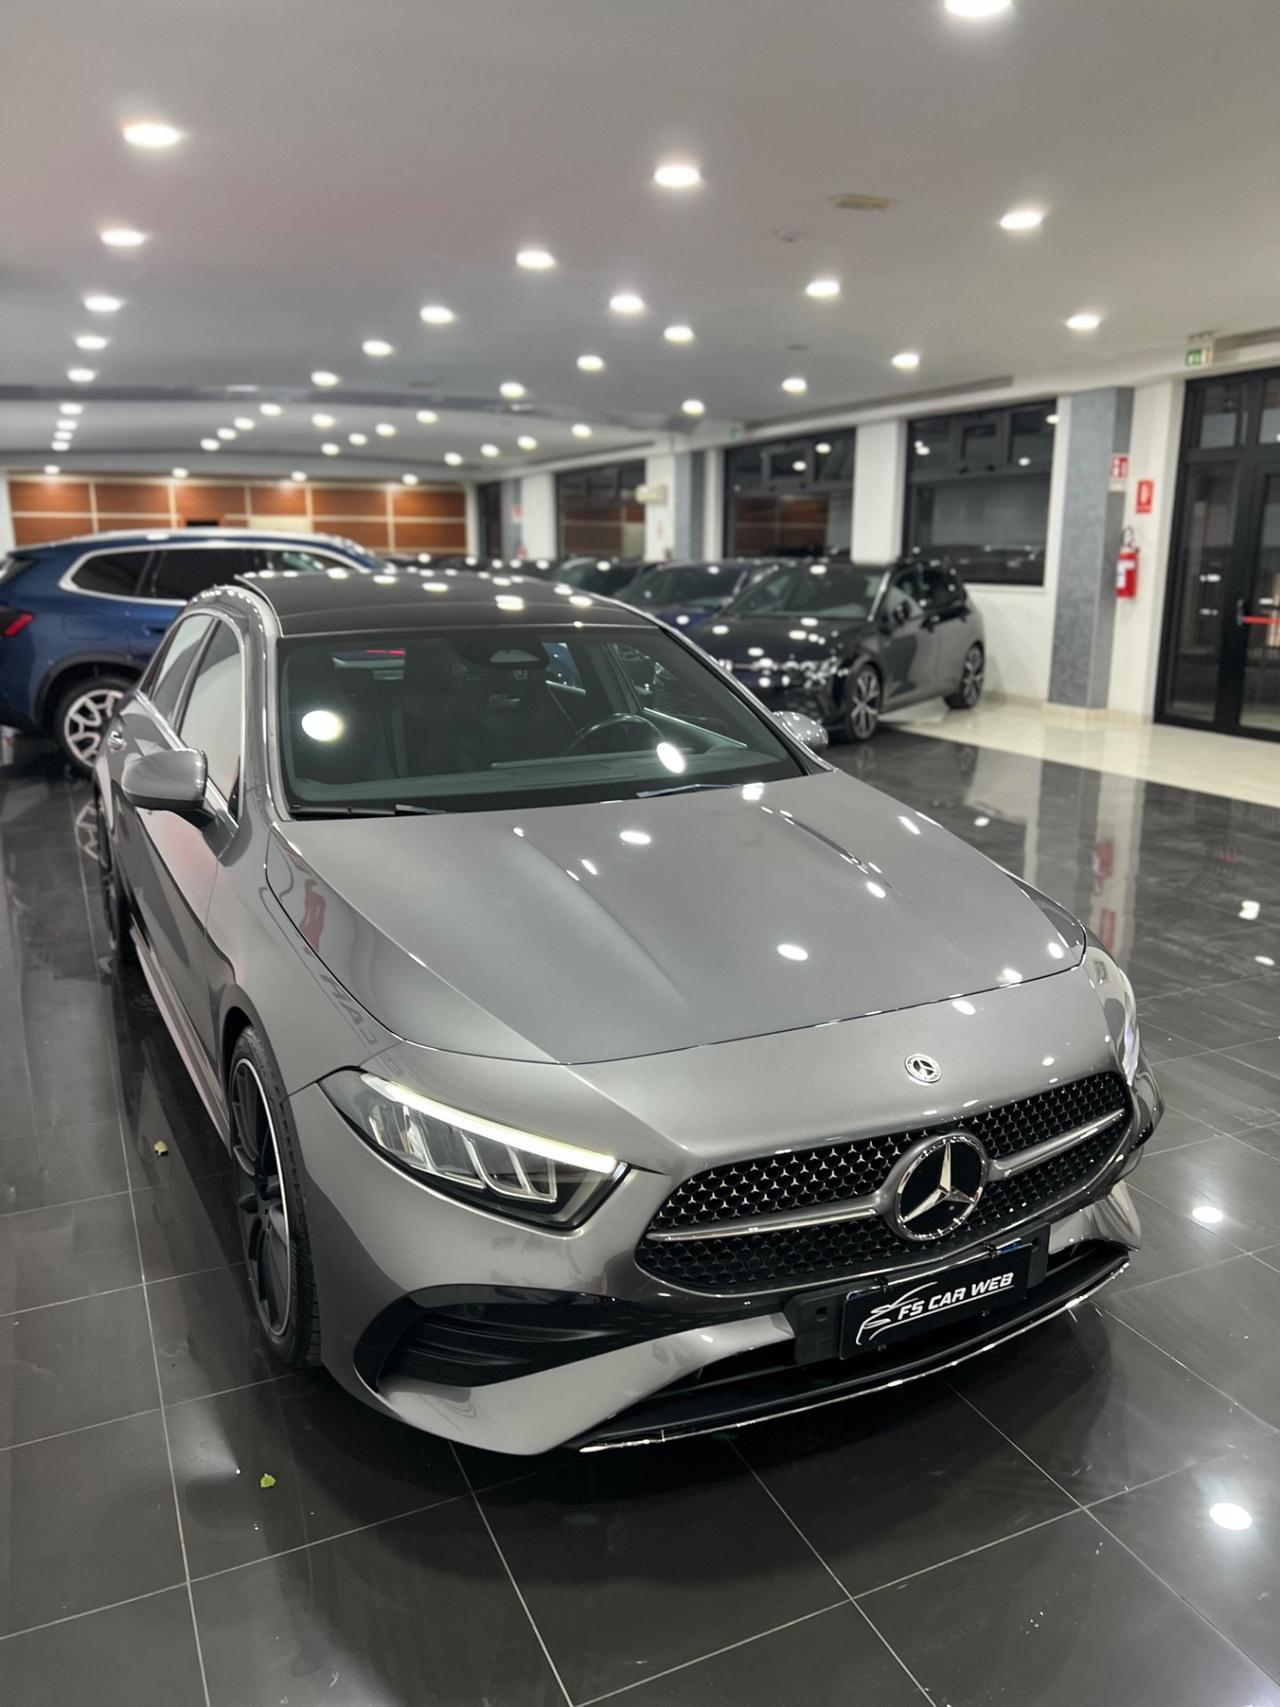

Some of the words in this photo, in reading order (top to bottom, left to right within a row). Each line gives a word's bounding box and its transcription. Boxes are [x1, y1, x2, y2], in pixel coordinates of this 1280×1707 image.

[897, 1300, 925, 1320] FS
[928, 1288, 967, 1310] CAR
[971, 1272, 1014, 1296] WEB
